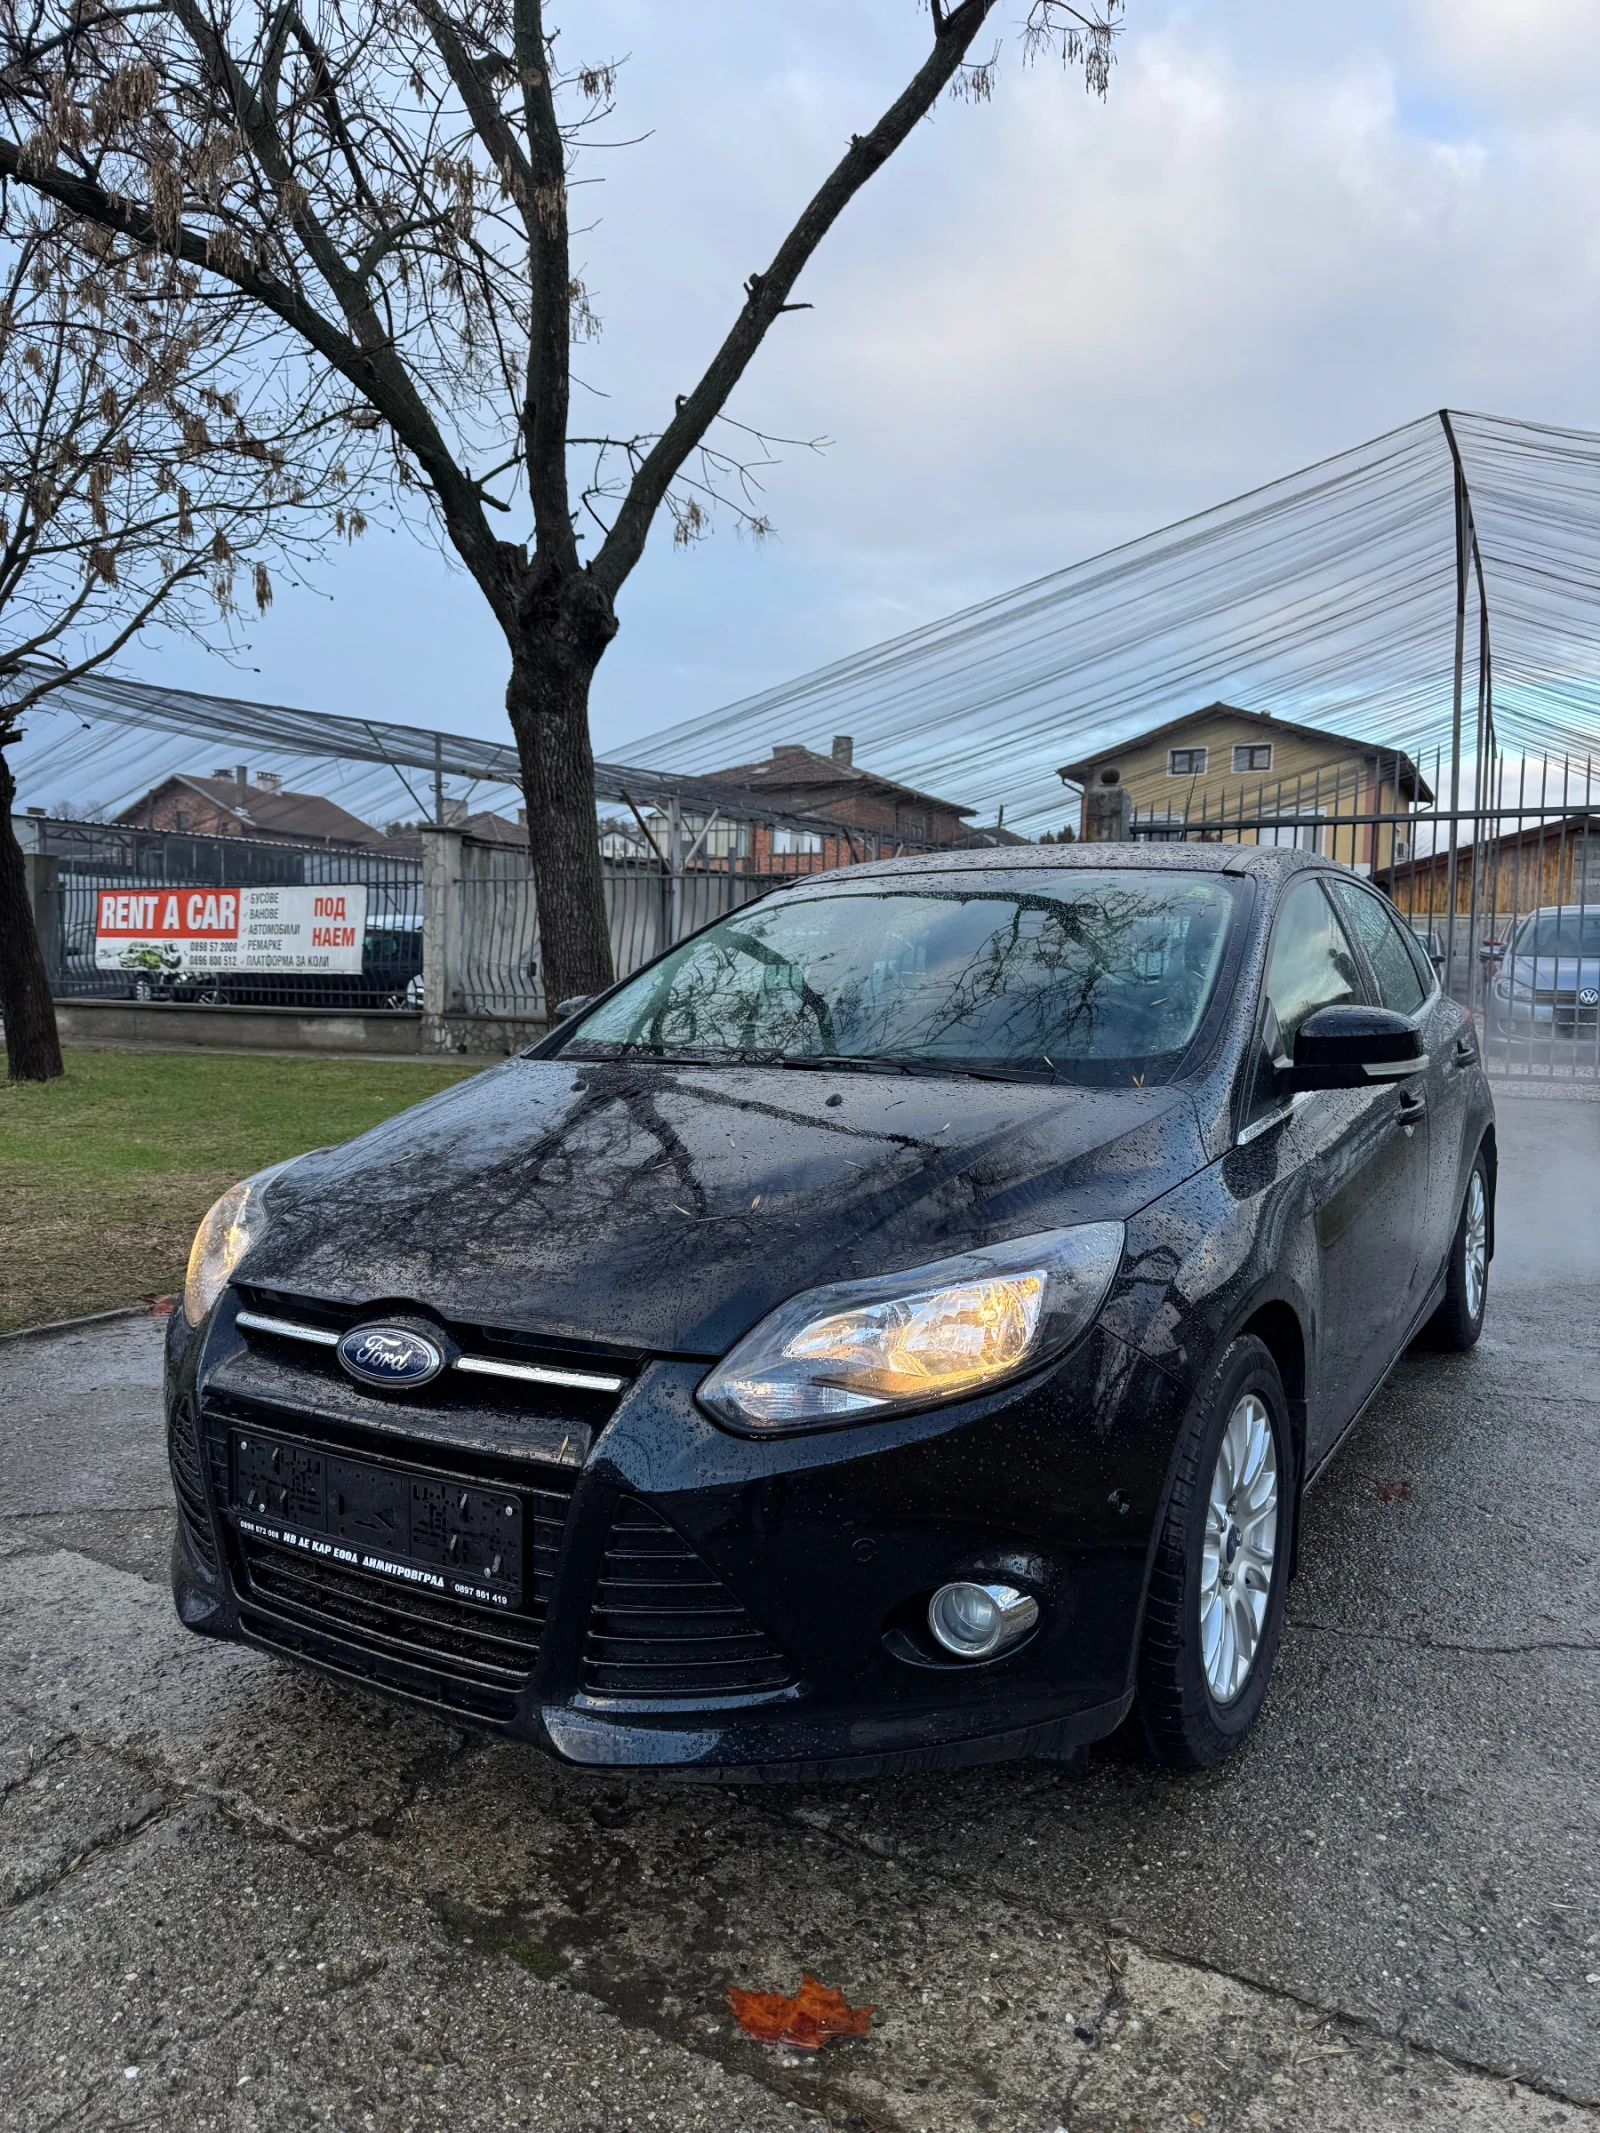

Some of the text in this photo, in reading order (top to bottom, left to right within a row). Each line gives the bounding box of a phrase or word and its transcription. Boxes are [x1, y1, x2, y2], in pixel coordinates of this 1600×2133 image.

[251, 893, 279, 904] БУСОВЕ
[101, 894, 236, 930] RENT A CAR
[249, 908, 279, 919] ВАНОВЕ
[314, 897, 346, 921] ПОД
[248, 924, 300, 935] АВТОМОБИЛИ
[312, 928, 355, 946] НАЕМ
[190, 941, 208, 952] 0898
[209, 942, 219, 952] 57
[247, 940, 282, 950] РЕМАРКЕ
[223, 956, 237, 966] 512
[246, 955, 329, 967] ПЛАТФОРМА ЗА КОЛИ
[356, 1335, 414, 1371] Ford
[298, 1537, 309, 1549] ДЕ
[312, 1541, 331, 1554] КАР
[333, 1547, 358, 1563] ЕООД
[362, 1556, 445, 1588] ДИМИТРОВГРАД
[455, 1583, 474, 1596] 0897
[492, 1595, 507, 1605] 419
